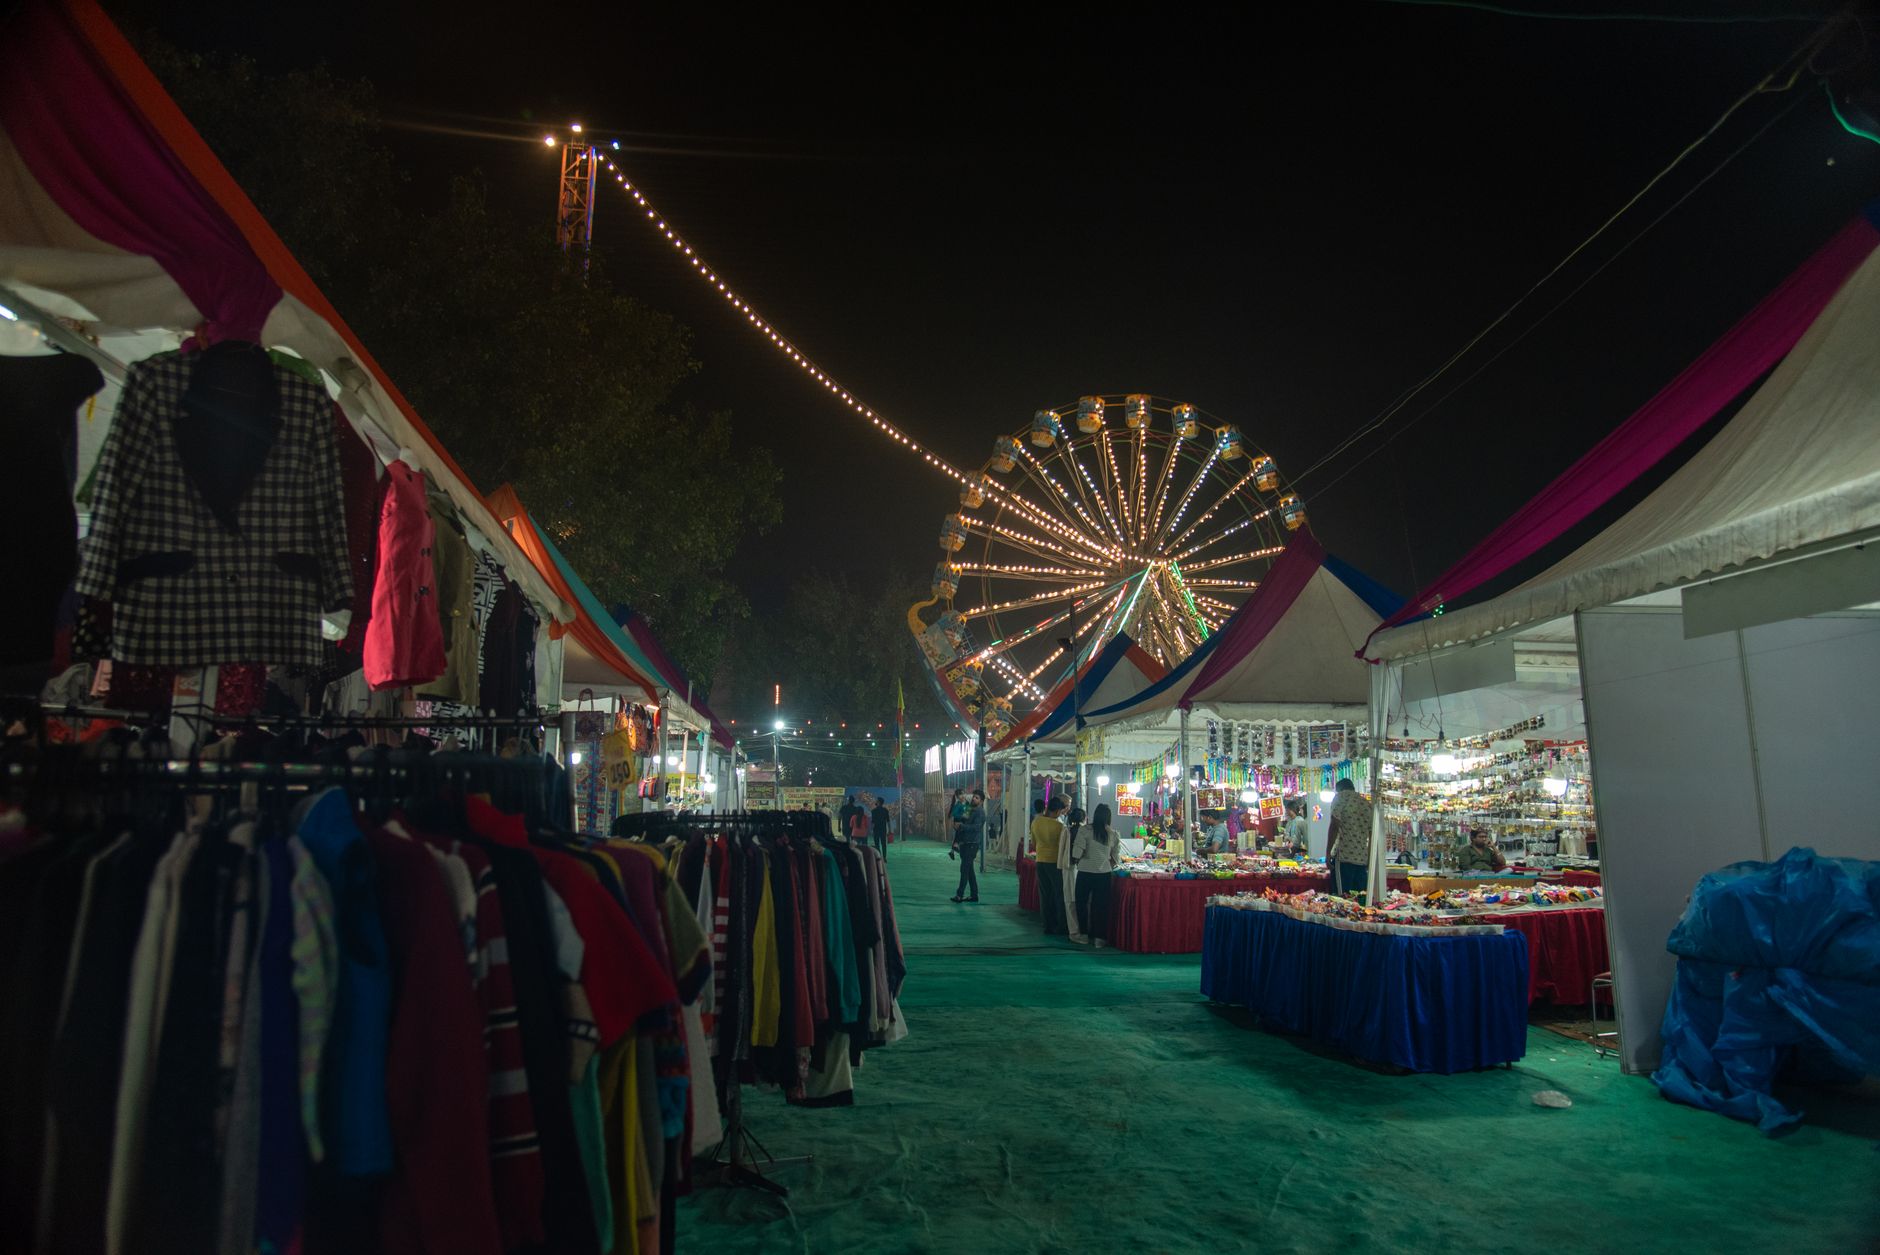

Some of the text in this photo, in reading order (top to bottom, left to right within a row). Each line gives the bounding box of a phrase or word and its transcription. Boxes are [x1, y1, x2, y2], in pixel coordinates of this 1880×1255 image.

[1120, 798, 1141, 807] SALE
[1261, 798, 1282, 808] SALE
[1270, 807, 1281, 816] 20
